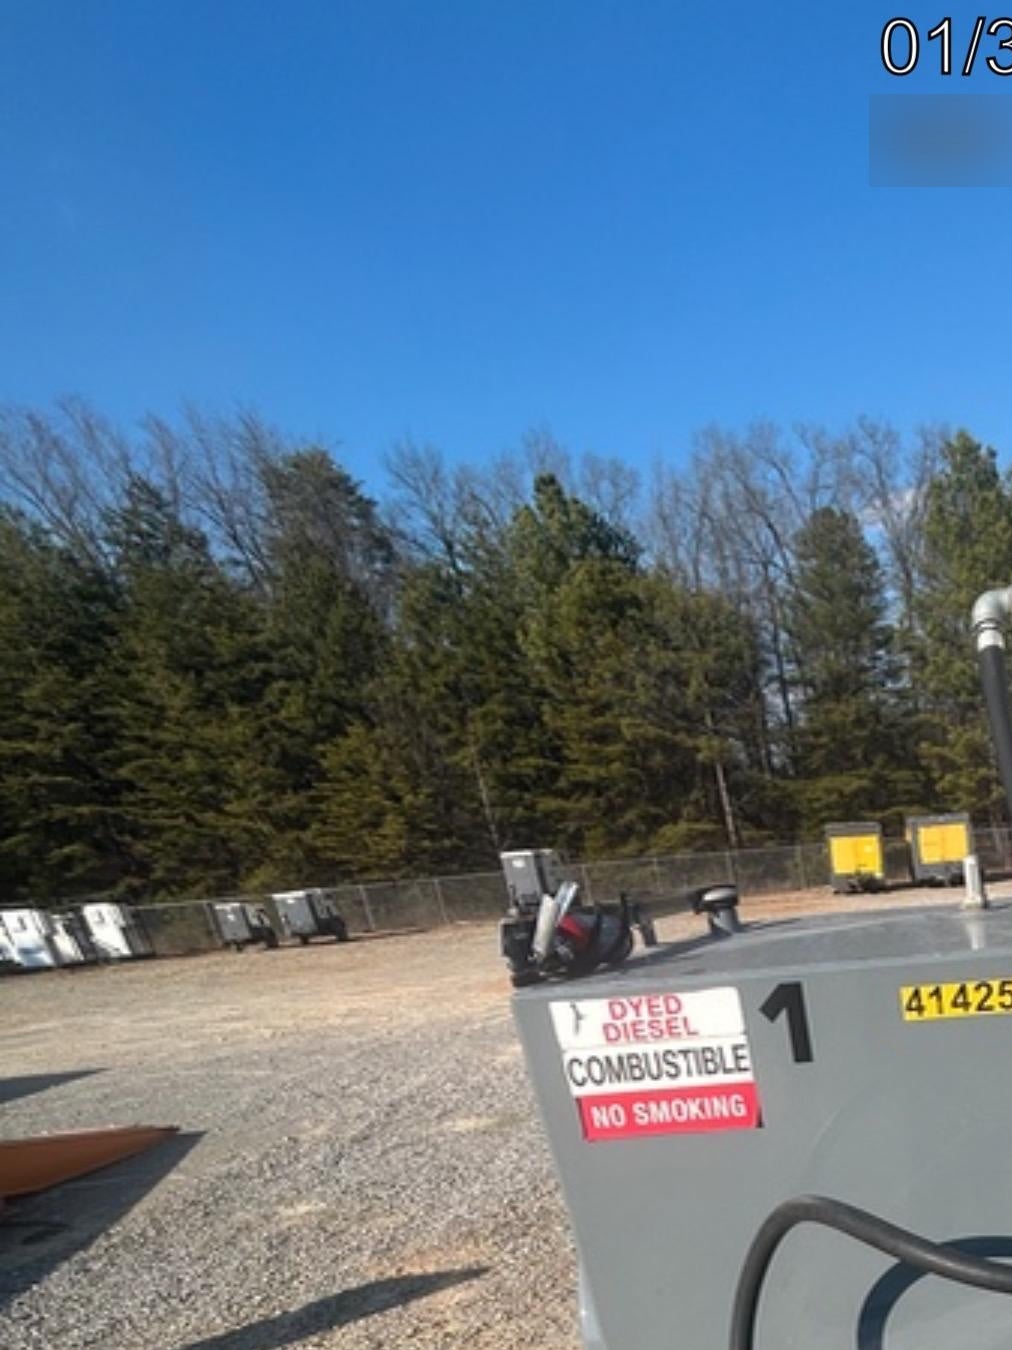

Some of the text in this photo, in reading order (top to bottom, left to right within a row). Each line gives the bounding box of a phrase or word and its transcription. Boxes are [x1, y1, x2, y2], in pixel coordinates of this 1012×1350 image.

[608, 994, 682, 1021] DYED
[758, 981, 814, 1064] 1
[602, 1016, 700, 1043] DIESEL
[566, 1044, 751, 1088] COMBUSTIBLE
[591, 1094, 748, 1130] NO SMOKING
